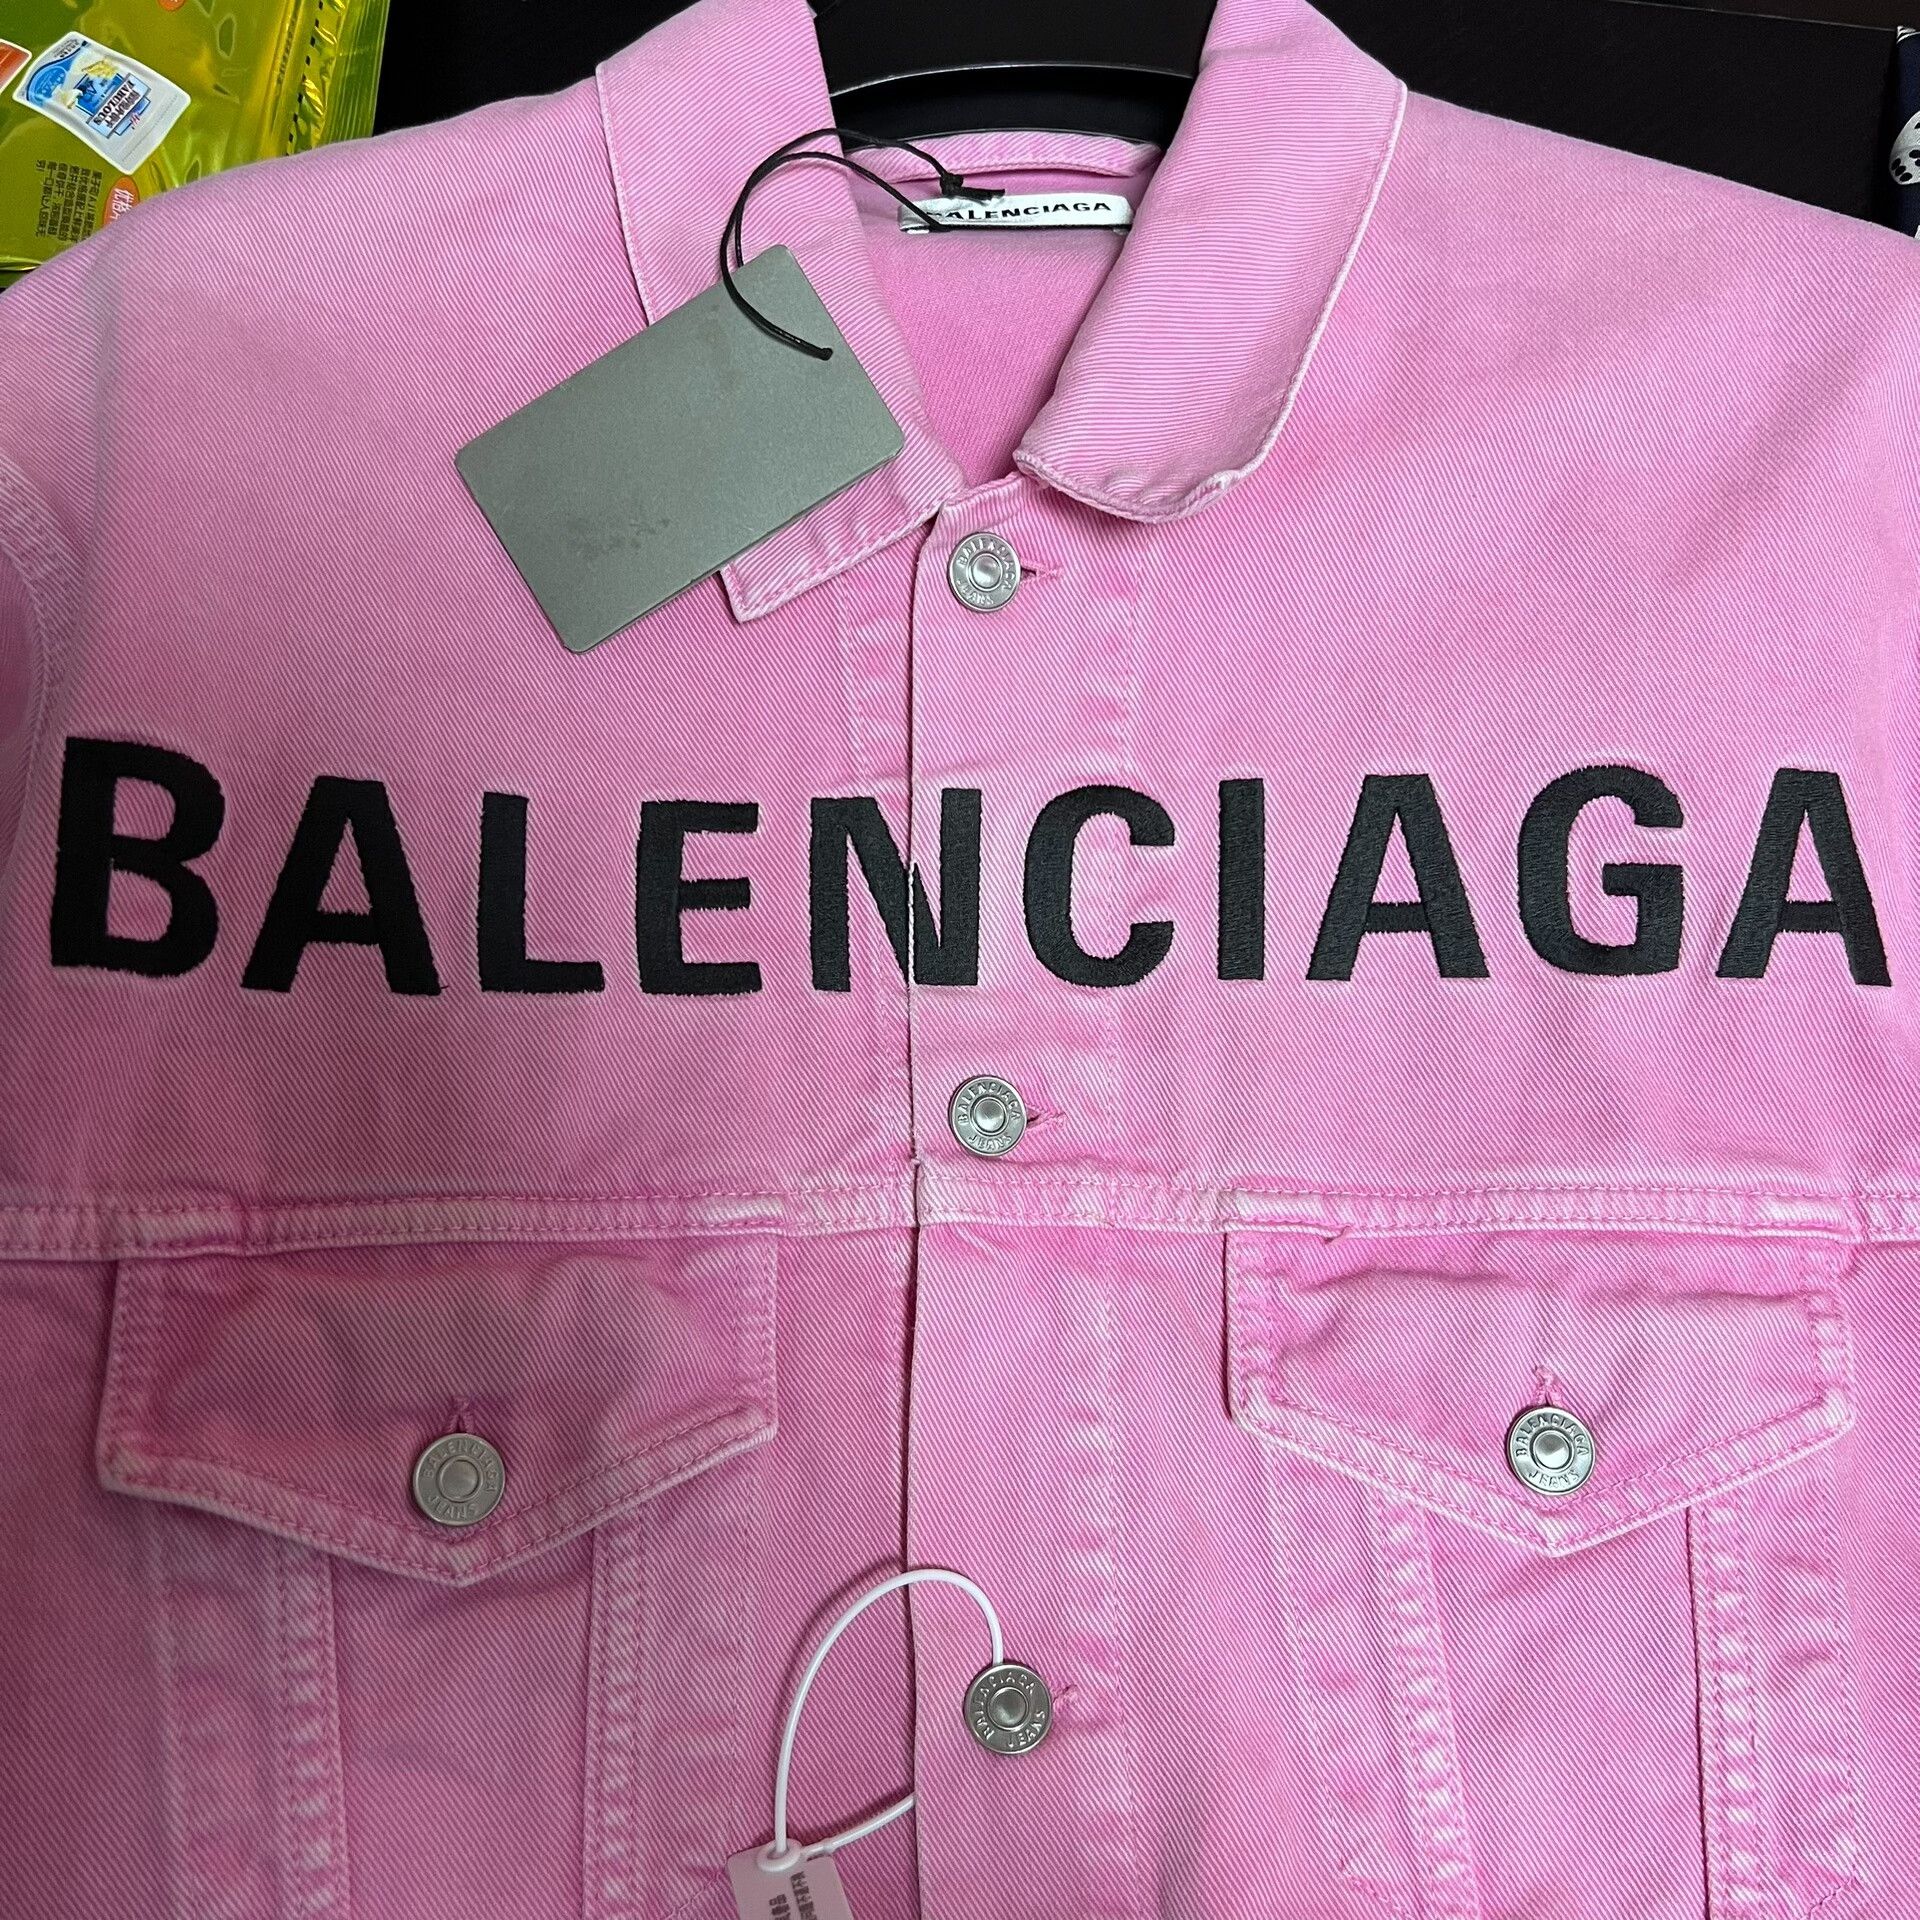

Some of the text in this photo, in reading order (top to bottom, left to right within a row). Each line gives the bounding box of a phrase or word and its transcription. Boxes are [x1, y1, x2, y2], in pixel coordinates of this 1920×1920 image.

[93, 81, 135, 126] FABULOUS
[926, 202, 1113, 220] ALENCIAGA
[49, 736, 1892, 997] BALENCIAGA
[968, 1131, 1012, 1150] JEANS
[1515, 1412, 1590, 1457] BALENCIAGA
[1528, 1468, 1580, 1489] JEANS
[428, 1494, 480, 1520] JEANS
